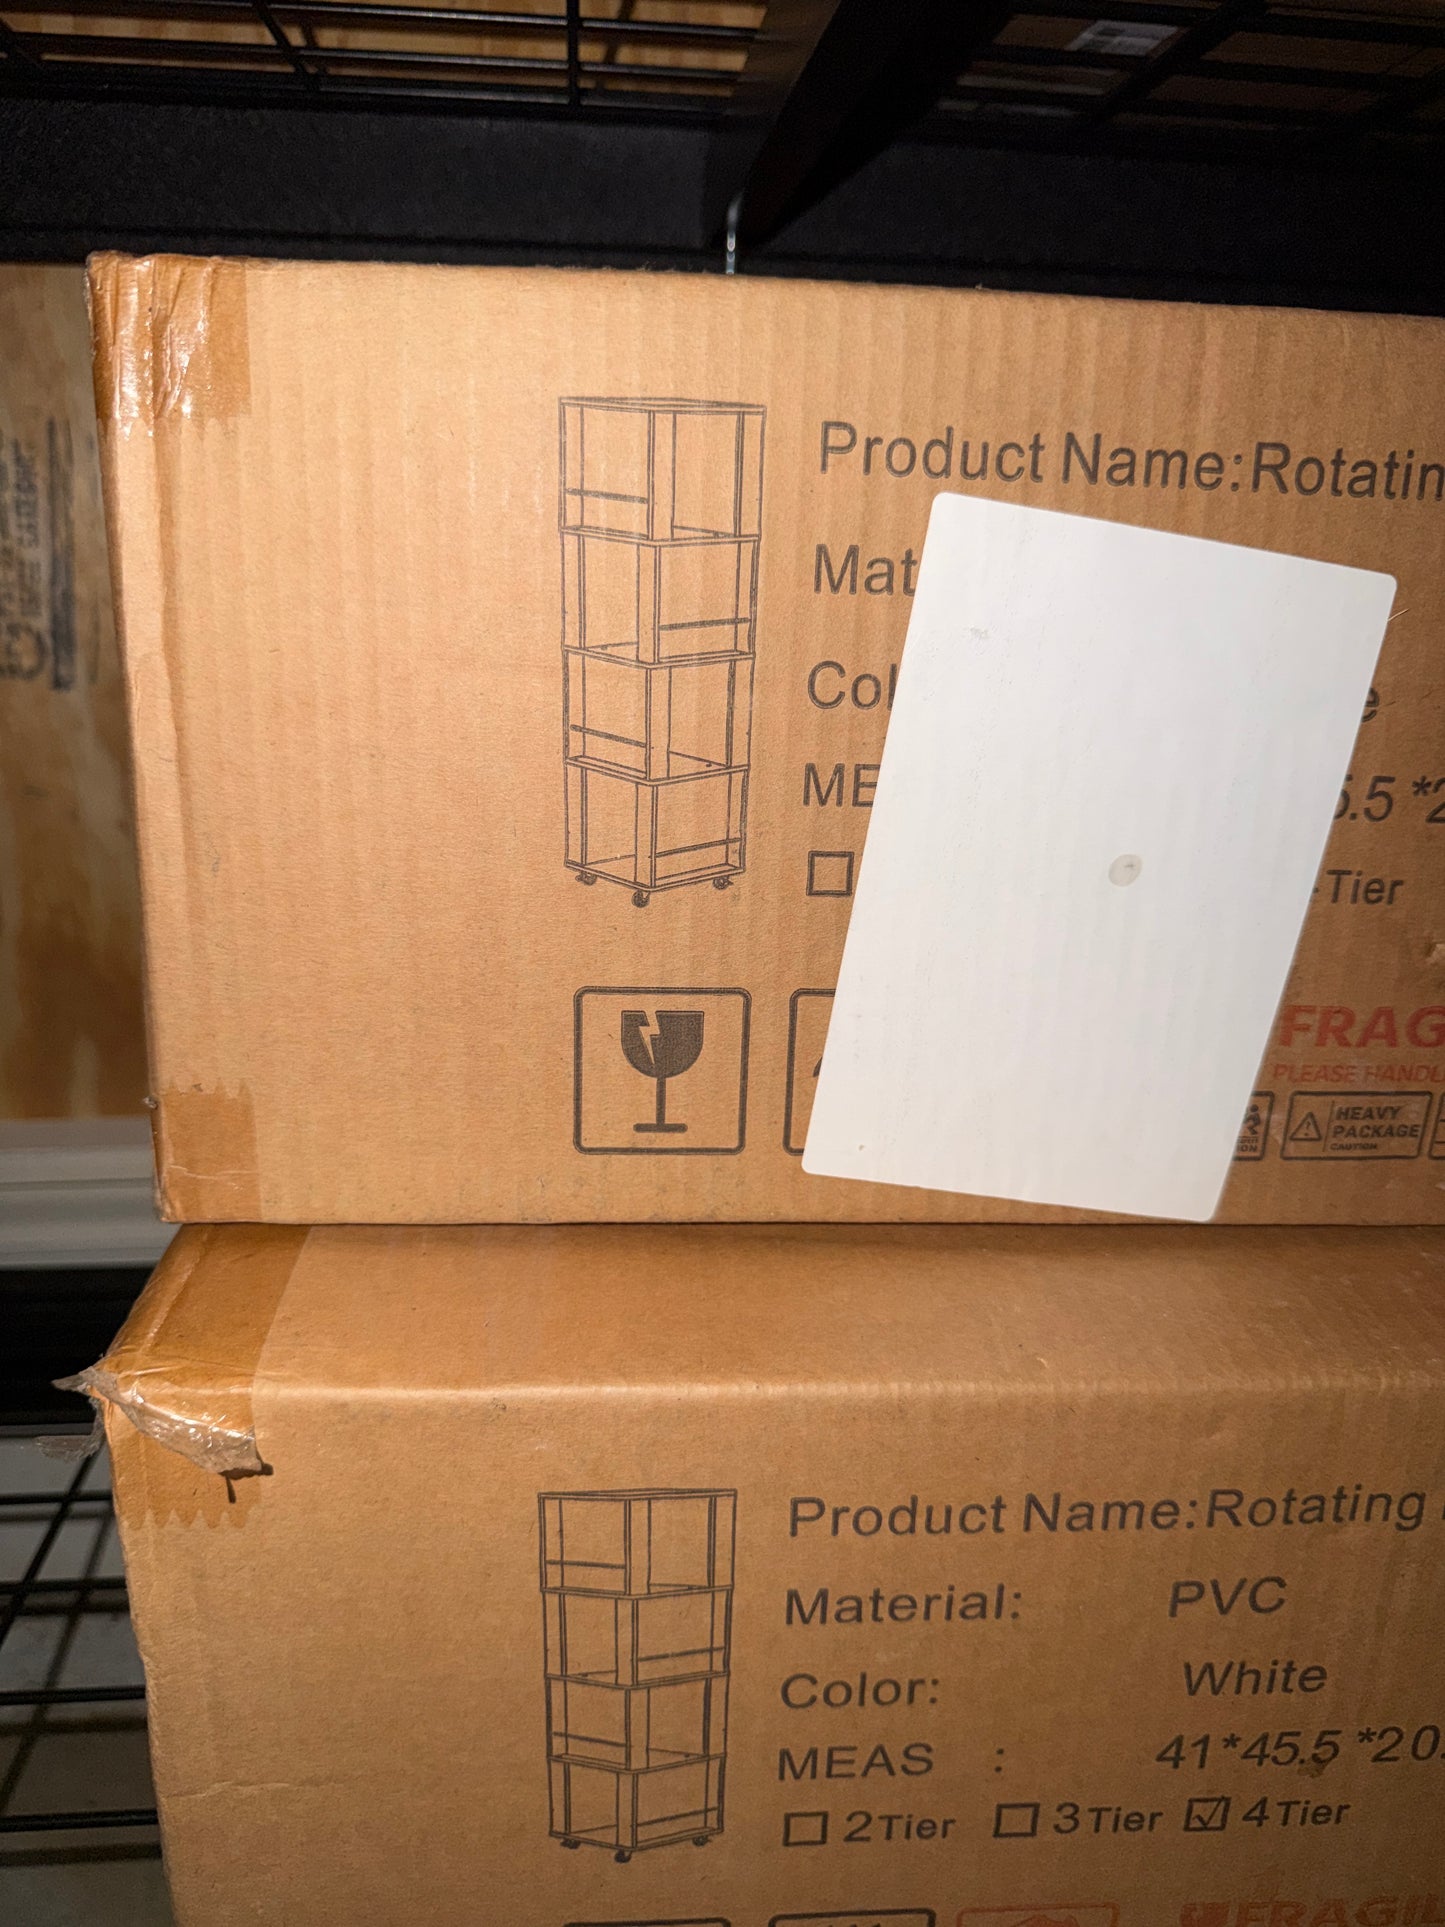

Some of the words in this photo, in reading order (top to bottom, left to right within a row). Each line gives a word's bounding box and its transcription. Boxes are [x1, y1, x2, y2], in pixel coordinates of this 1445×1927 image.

[819, 421, 1046, 484] Product
[1314, 869, 1404, 905] Tier
[1272, 1063, 1357, 1084] PLEASE
[1332, 1124, 1421, 1139] PACKAGE
[1336, 1106, 1401, 1121] HEAVY
[1330, 1141, 1377, 1151] CAUTION
[790, 1494, 1007, 1538] Product
[785, 1583, 1023, 1627] Material:
[1168, 1576, 1287, 1618] PVC
[780, 1672, 940, 1709] Color:
[1183, 1660, 1328, 1697] White
[778, 1742, 934, 1782] MEAS
